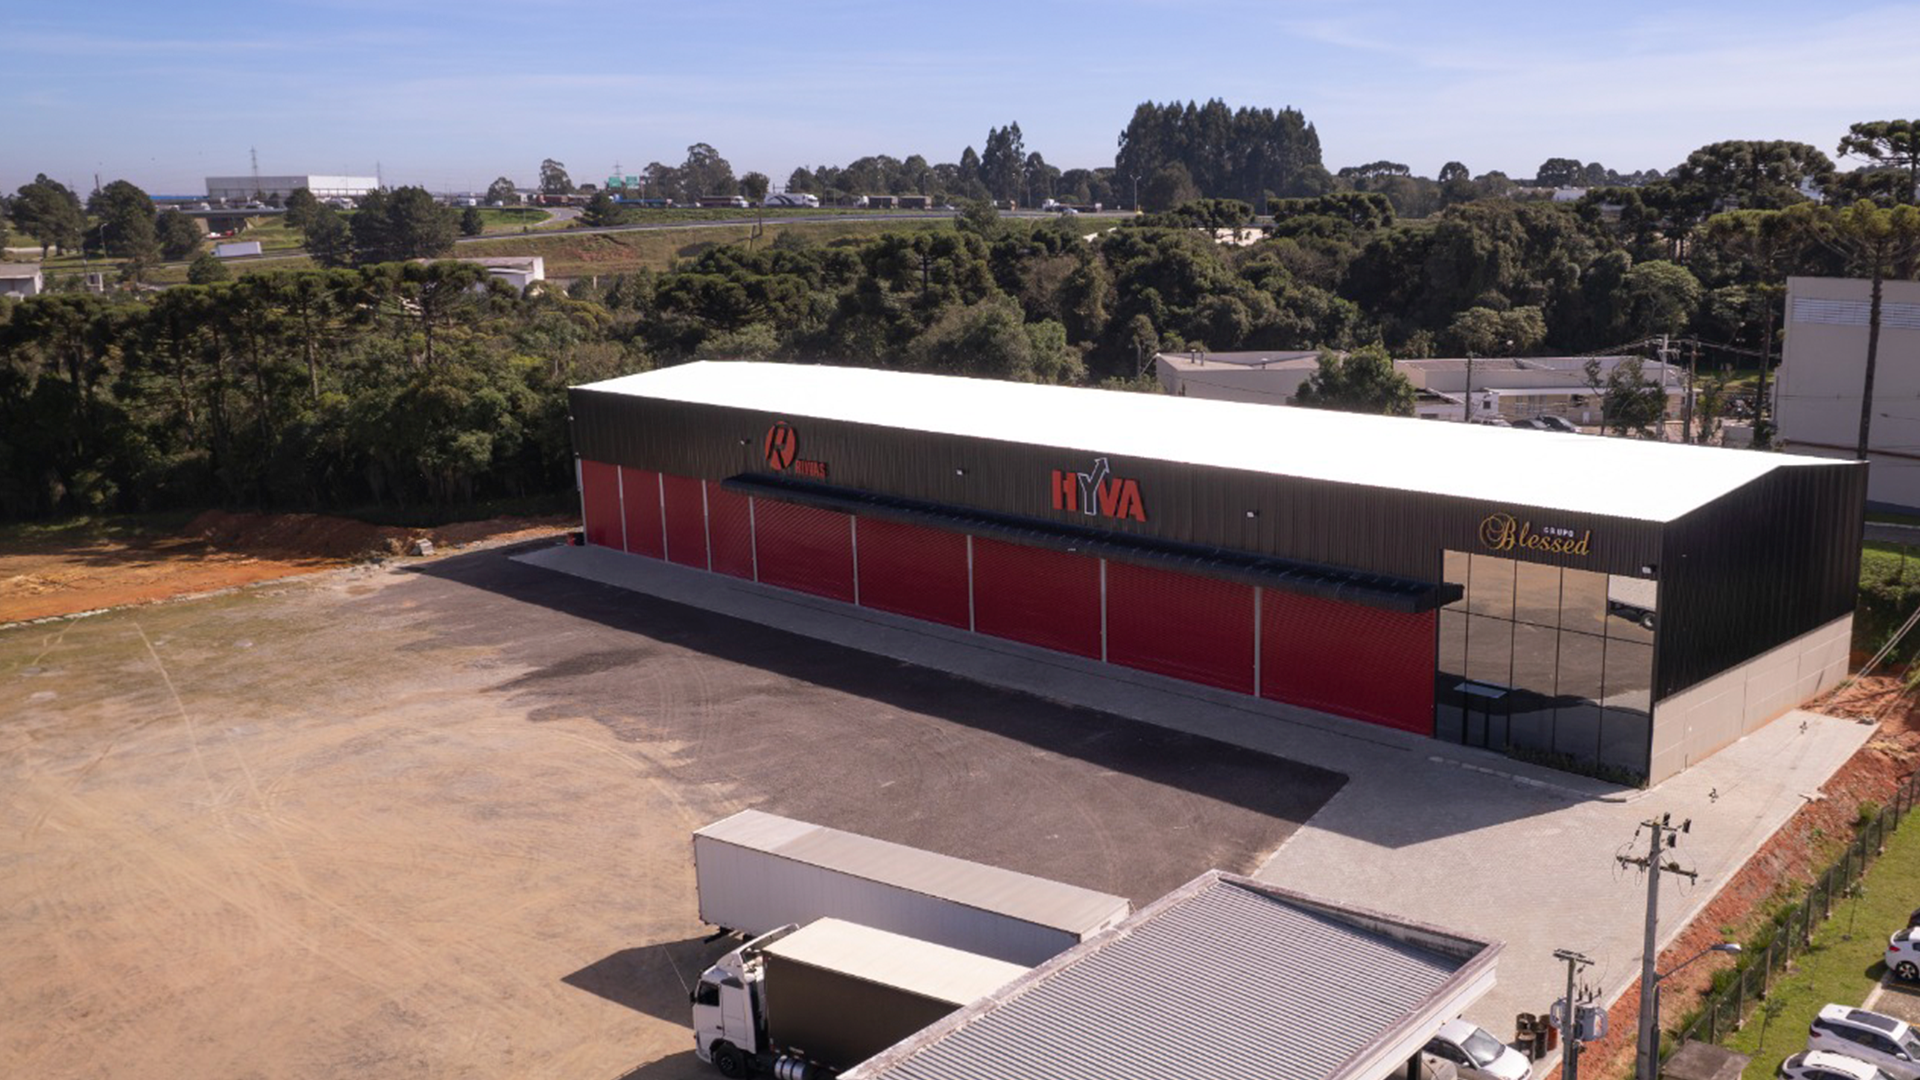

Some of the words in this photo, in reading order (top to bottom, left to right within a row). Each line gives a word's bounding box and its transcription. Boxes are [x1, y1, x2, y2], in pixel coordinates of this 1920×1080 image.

[1051, 457, 1147, 522] HYVA
[1480, 511, 1591, 556] Blessed
[1543, 526, 1574, 538] GRUPO
